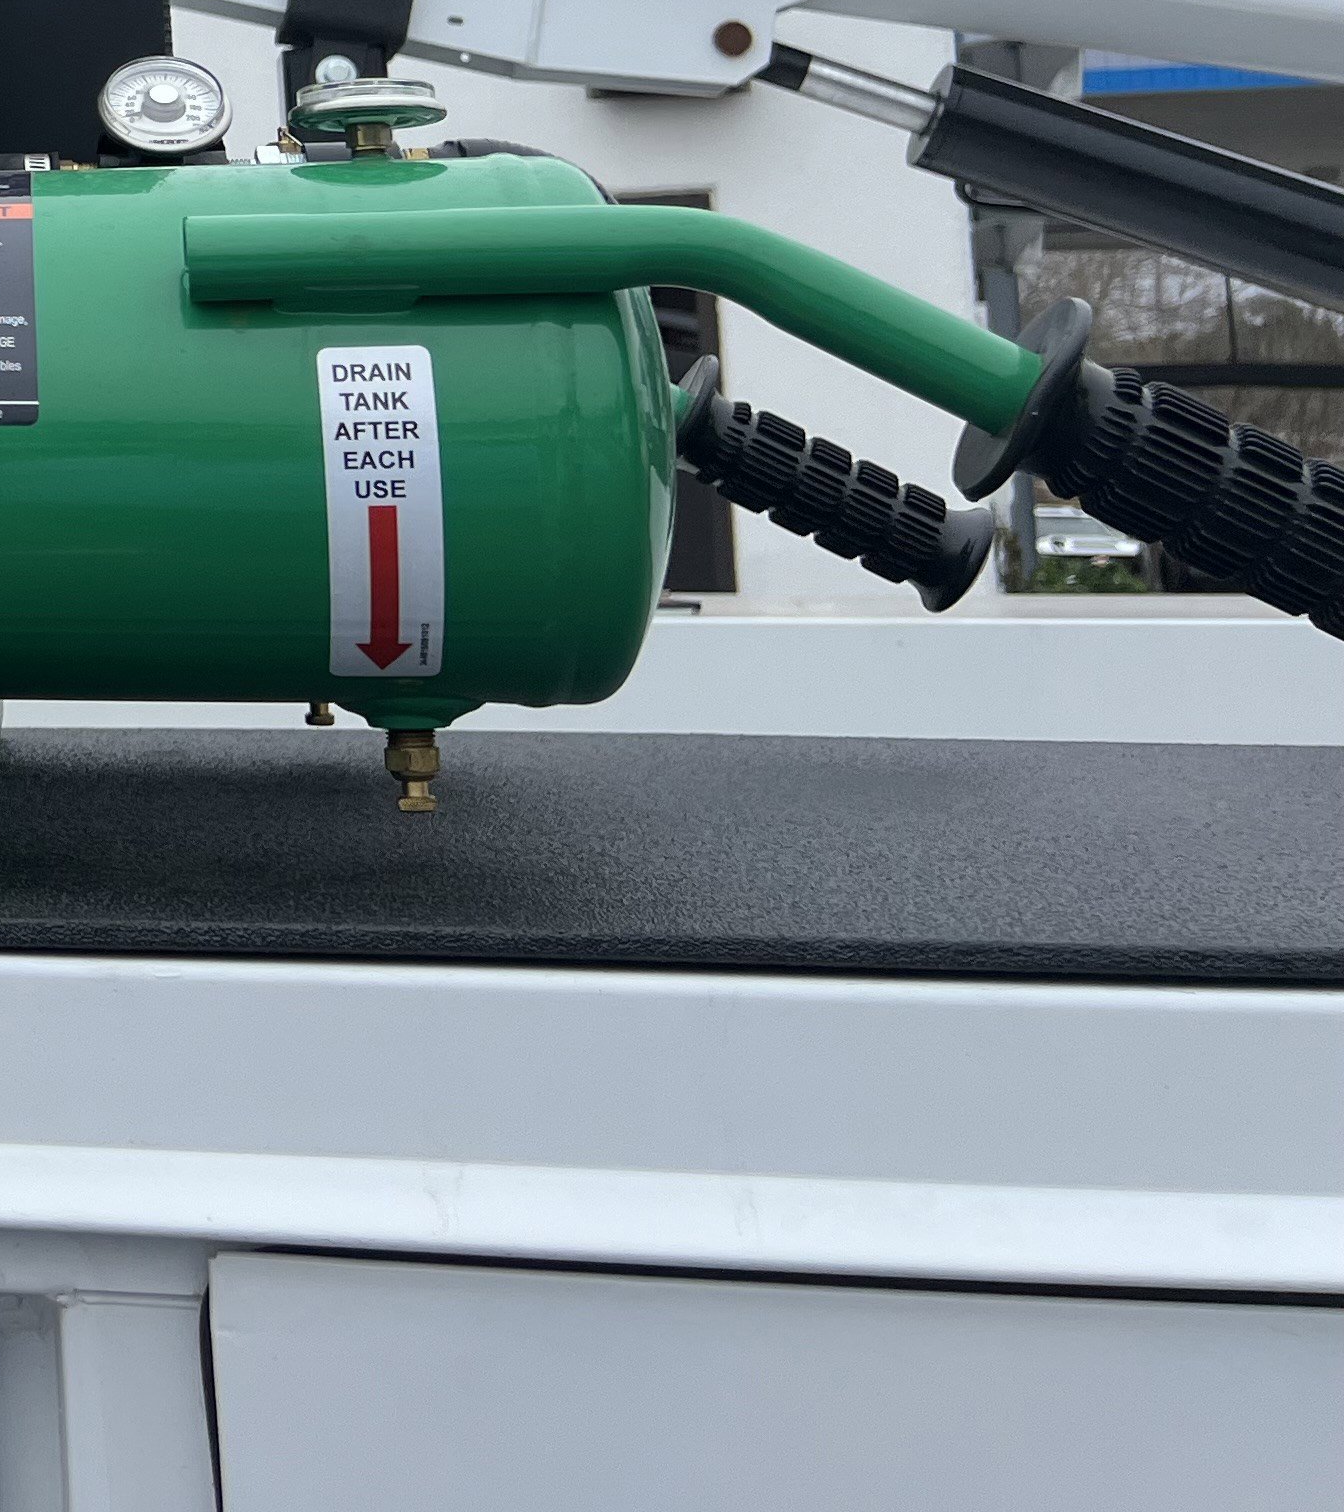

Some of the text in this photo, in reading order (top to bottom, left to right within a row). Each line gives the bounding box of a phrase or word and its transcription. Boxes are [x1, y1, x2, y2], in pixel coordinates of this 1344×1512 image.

[332, 362, 412, 382] DRAIN
[339, 392, 409, 411] TANK
[334, 421, 420, 440] AFTER
[344, 450, 415, 470] EACH
[354, 480, 407, 499] USE
